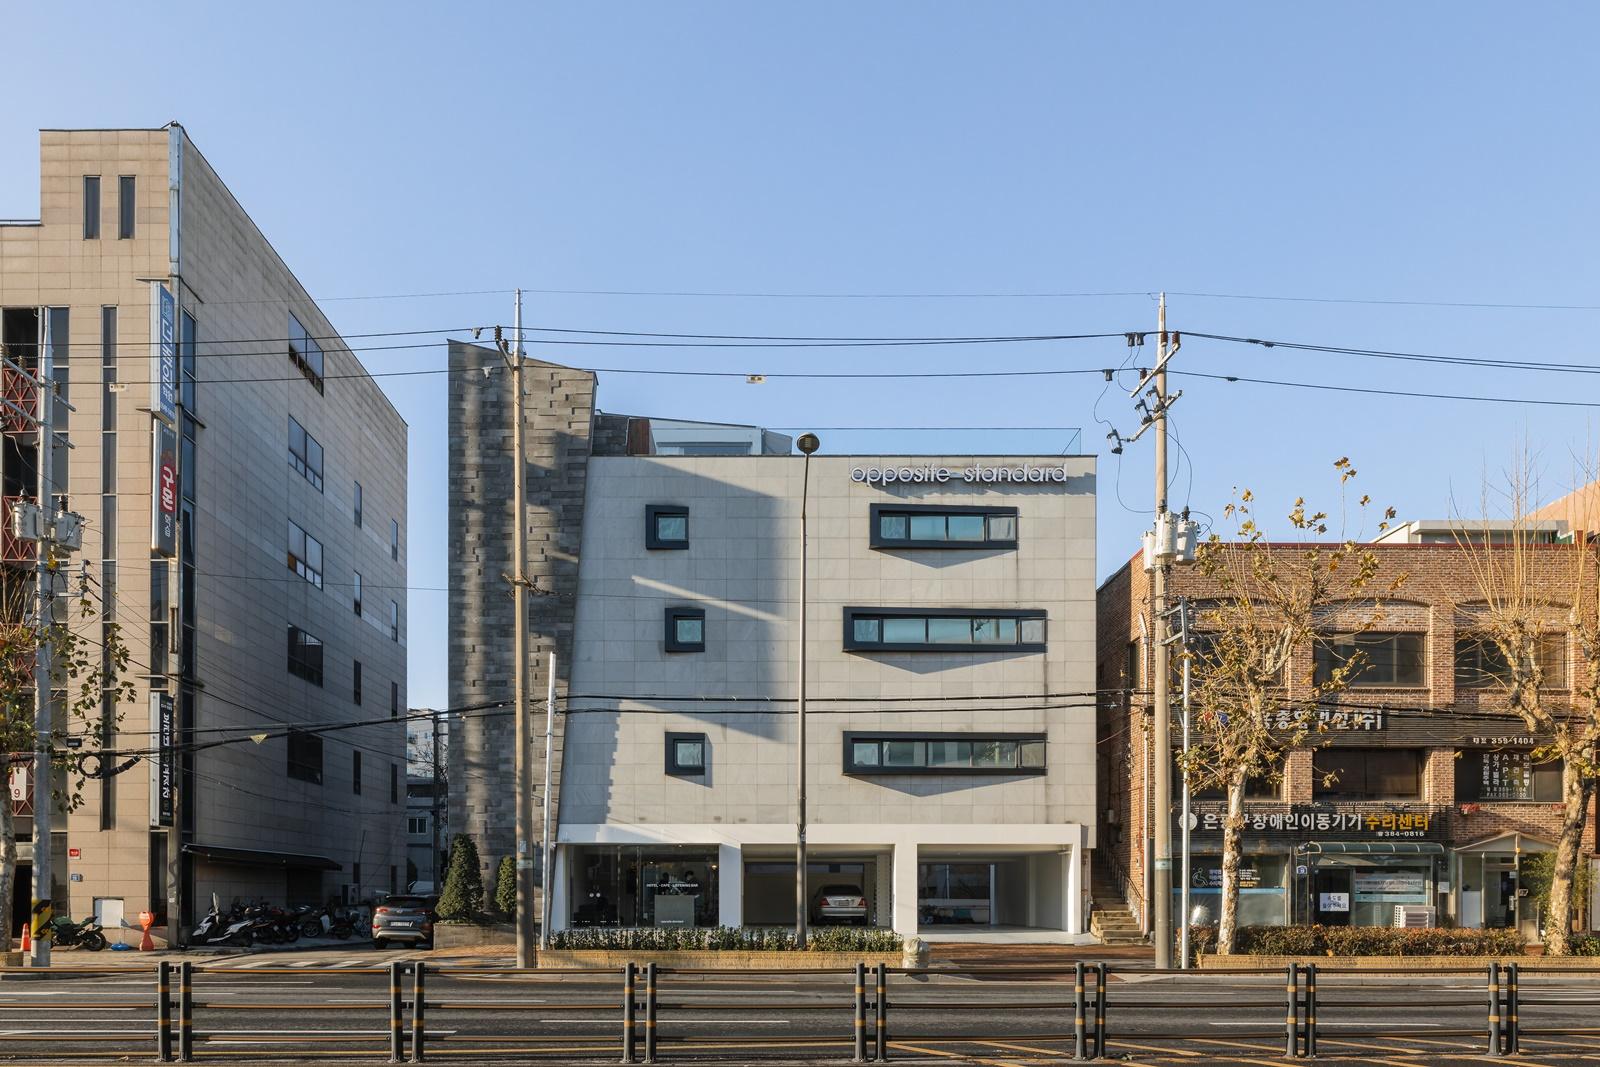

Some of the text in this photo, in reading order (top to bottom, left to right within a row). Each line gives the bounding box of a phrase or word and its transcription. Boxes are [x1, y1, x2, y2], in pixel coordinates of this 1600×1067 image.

[851, 463, 1067, 485] opposite standard
[163, 466, 175, 511] 구몬
[1202, 812, 1430, 831] 은장애인이동기기 수리센터
